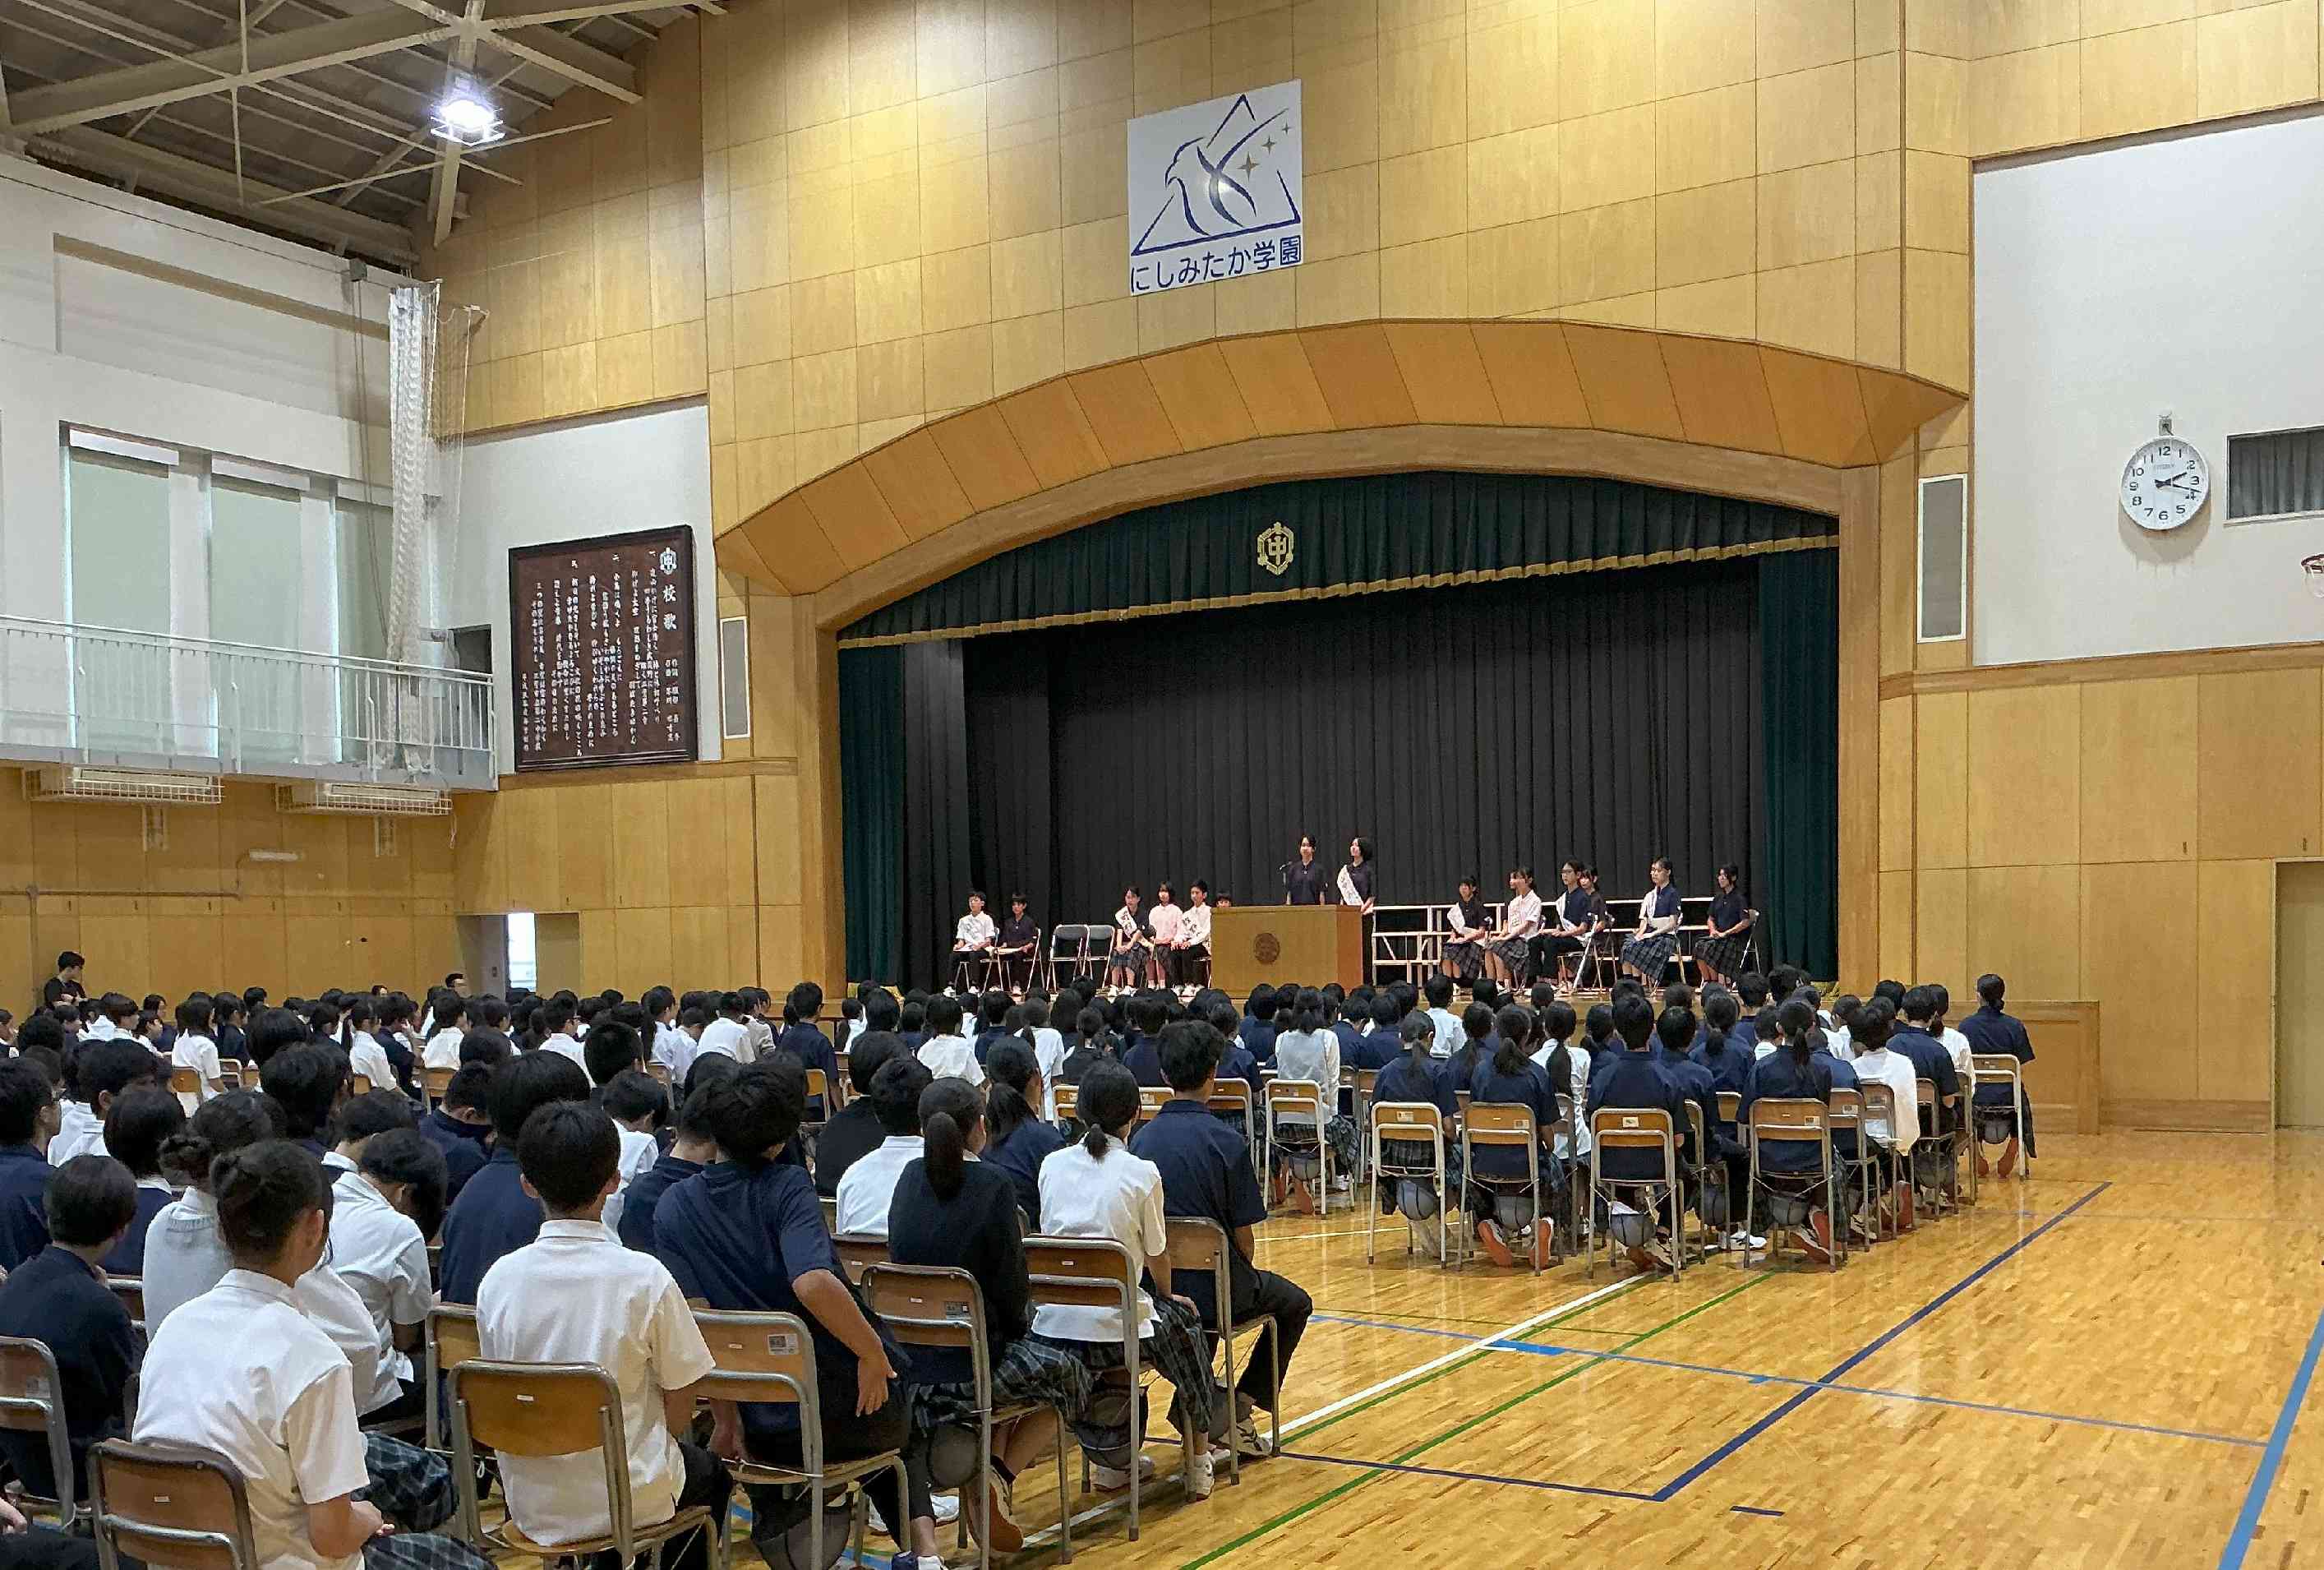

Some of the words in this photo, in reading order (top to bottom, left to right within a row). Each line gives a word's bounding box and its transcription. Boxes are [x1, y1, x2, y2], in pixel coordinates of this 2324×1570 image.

[1132, 234, 1302, 293] にしみたか学園
[2158, 446, 2170, 456] 12
[2143, 454, 2154, 464] 11
[2187, 459, 2196, 470] 2
[2132, 468, 2144, 477] 10
[2190, 476, 2200, 485] 3
[2129, 482, 2139, 491] 9
[2185, 492, 2196, 500] 4
[2132, 496, 2142, 506] 8
[2144, 508, 2154, 517] 7
[2176, 505, 2186, 514] 5
[2158, 511, 2169, 520] 6
[662, 584, 677, 630] 校歌
